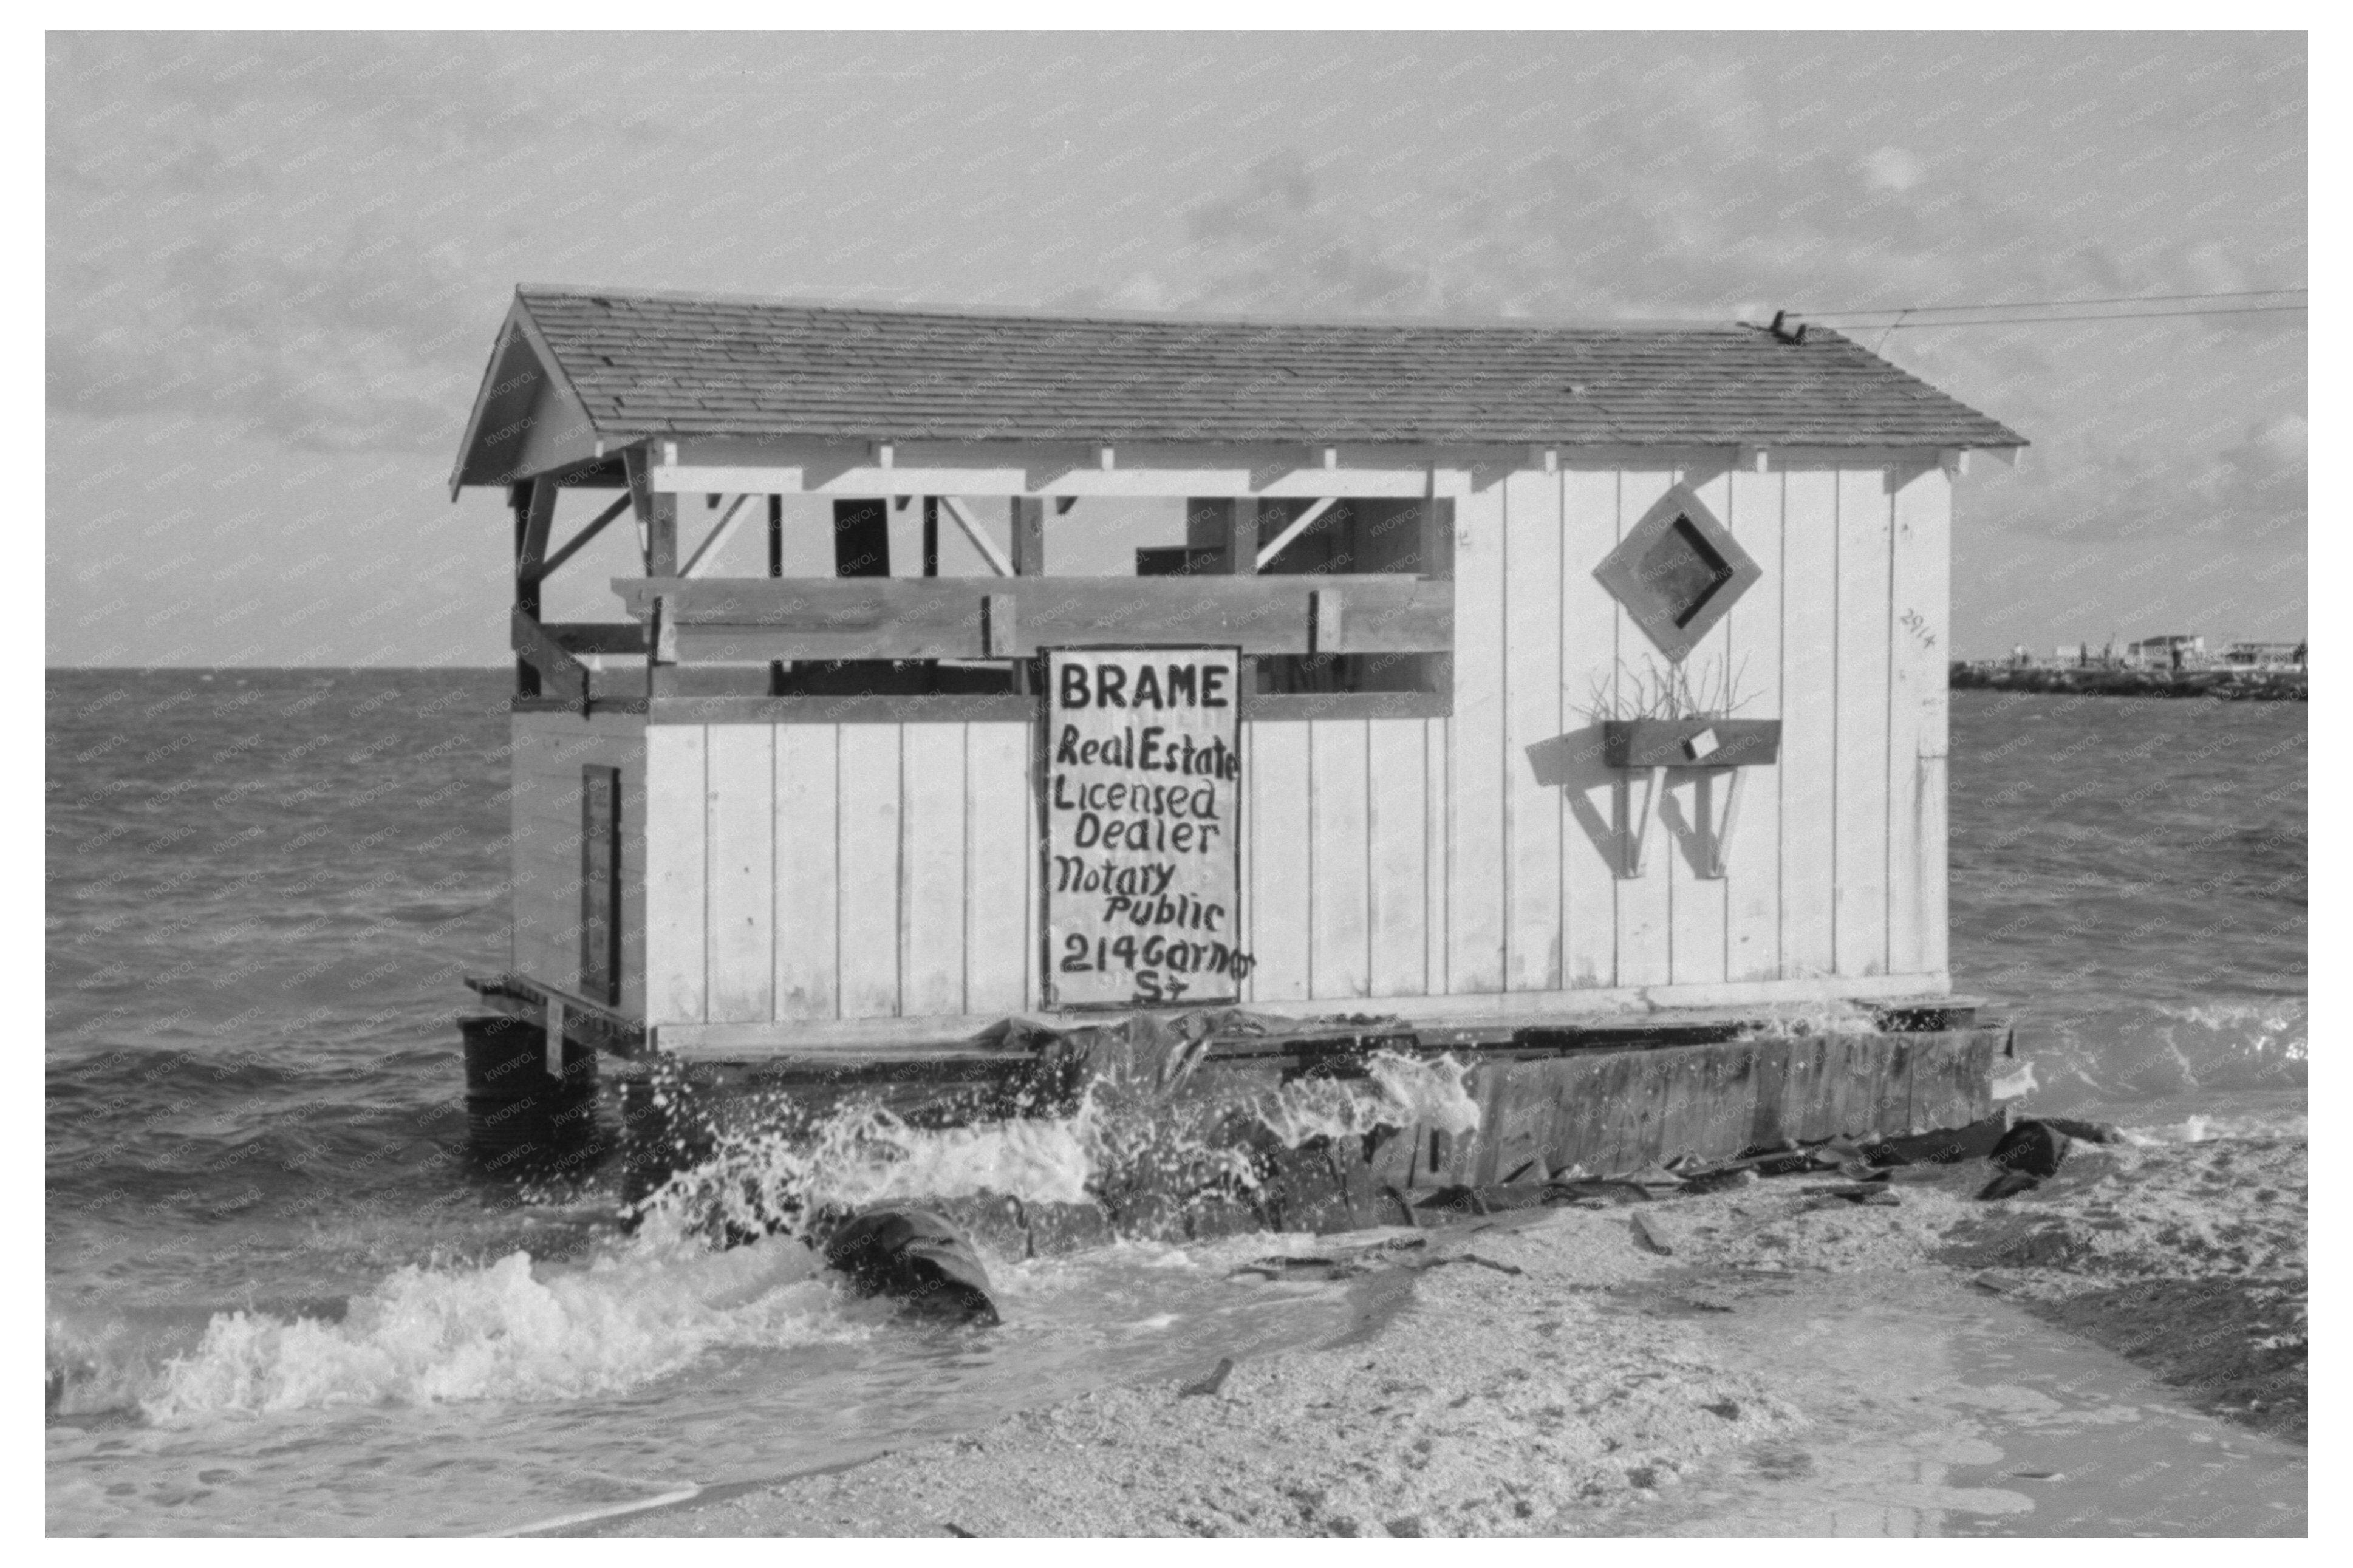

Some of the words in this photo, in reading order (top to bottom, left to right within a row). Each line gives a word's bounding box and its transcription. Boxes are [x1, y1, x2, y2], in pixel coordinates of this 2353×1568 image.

[1060, 663, 1229, 710] BRAME
[1057, 723, 1134, 769] Real
[1054, 773, 1220, 820] Licensed
[1074, 811, 1220, 853] Dealer
[1054, 854, 1177, 896] Notary
[1102, 891, 1226, 932] Public
[1060, 933, 1138, 972] 214
